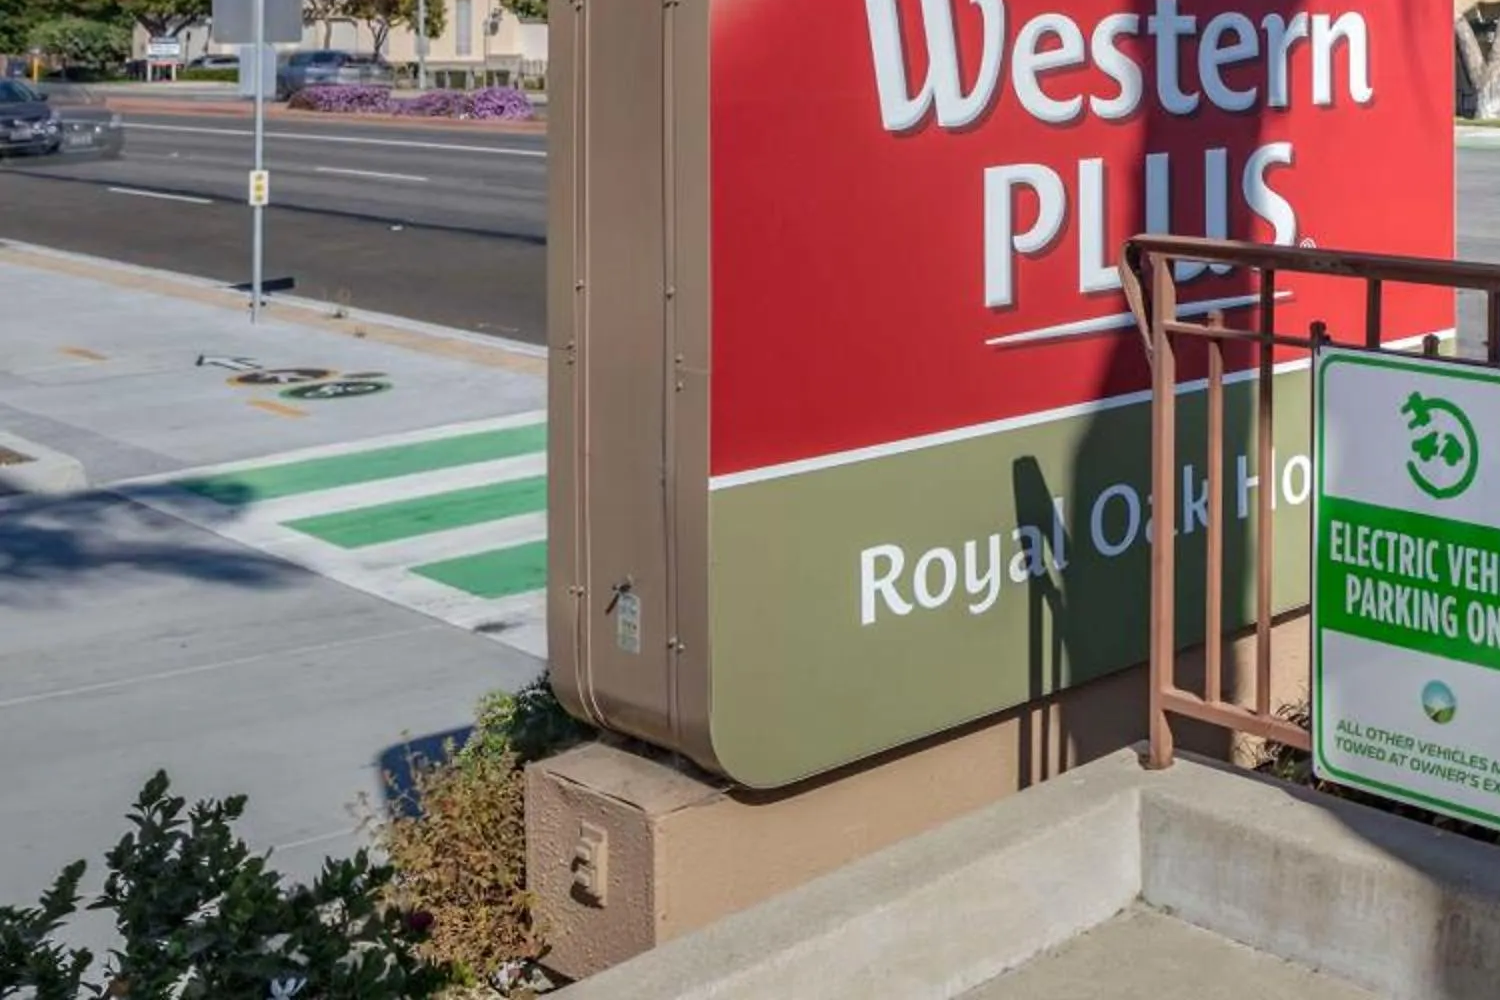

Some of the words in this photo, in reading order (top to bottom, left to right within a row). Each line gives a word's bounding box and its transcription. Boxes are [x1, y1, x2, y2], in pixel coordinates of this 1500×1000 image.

[983, 141, 1297, 308] PLUS
[860, 496, 1069, 625] Royal
[1330, 519, 1440, 583] ELECTRIC
[1345, 573, 1459, 639] PARKING
[1334, 736, 1387, 761] TOWED
[1388, 752, 1408, 768] AT
[1409, 758, 1481, 789] OWNER'S
[1335, 719, 1363, 738] ALL
[1364, 726, 1416, 752] OTHER
[1416, 738, 1489, 772] VEHICLES
